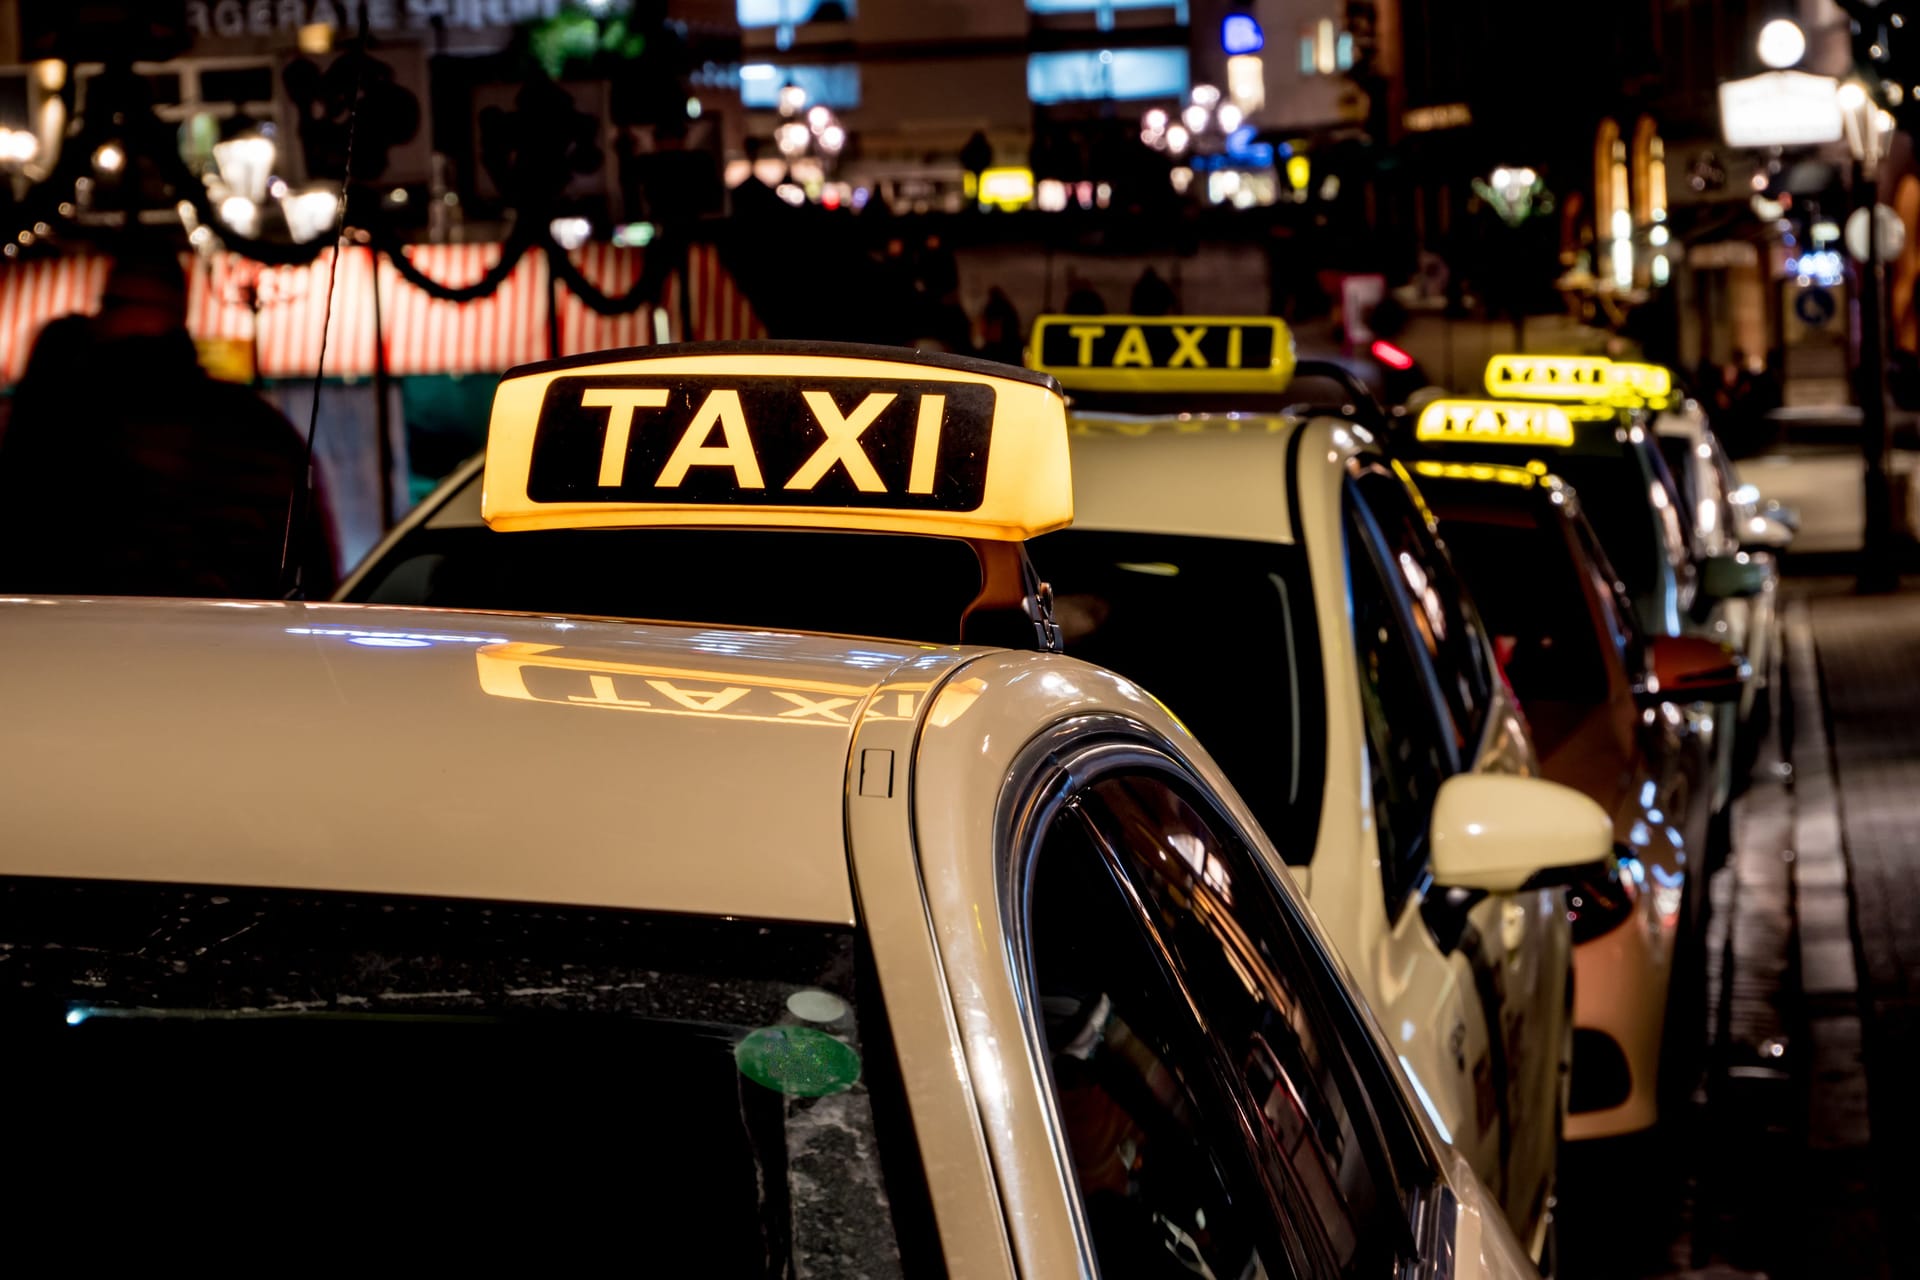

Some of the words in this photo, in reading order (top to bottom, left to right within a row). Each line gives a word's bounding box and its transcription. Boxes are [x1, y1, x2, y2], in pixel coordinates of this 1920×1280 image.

[1069, 326, 1243, 367] TAXI
[581, 388, 946, 494] TAXI
[1449, 407, 1547, 437] TAXI
